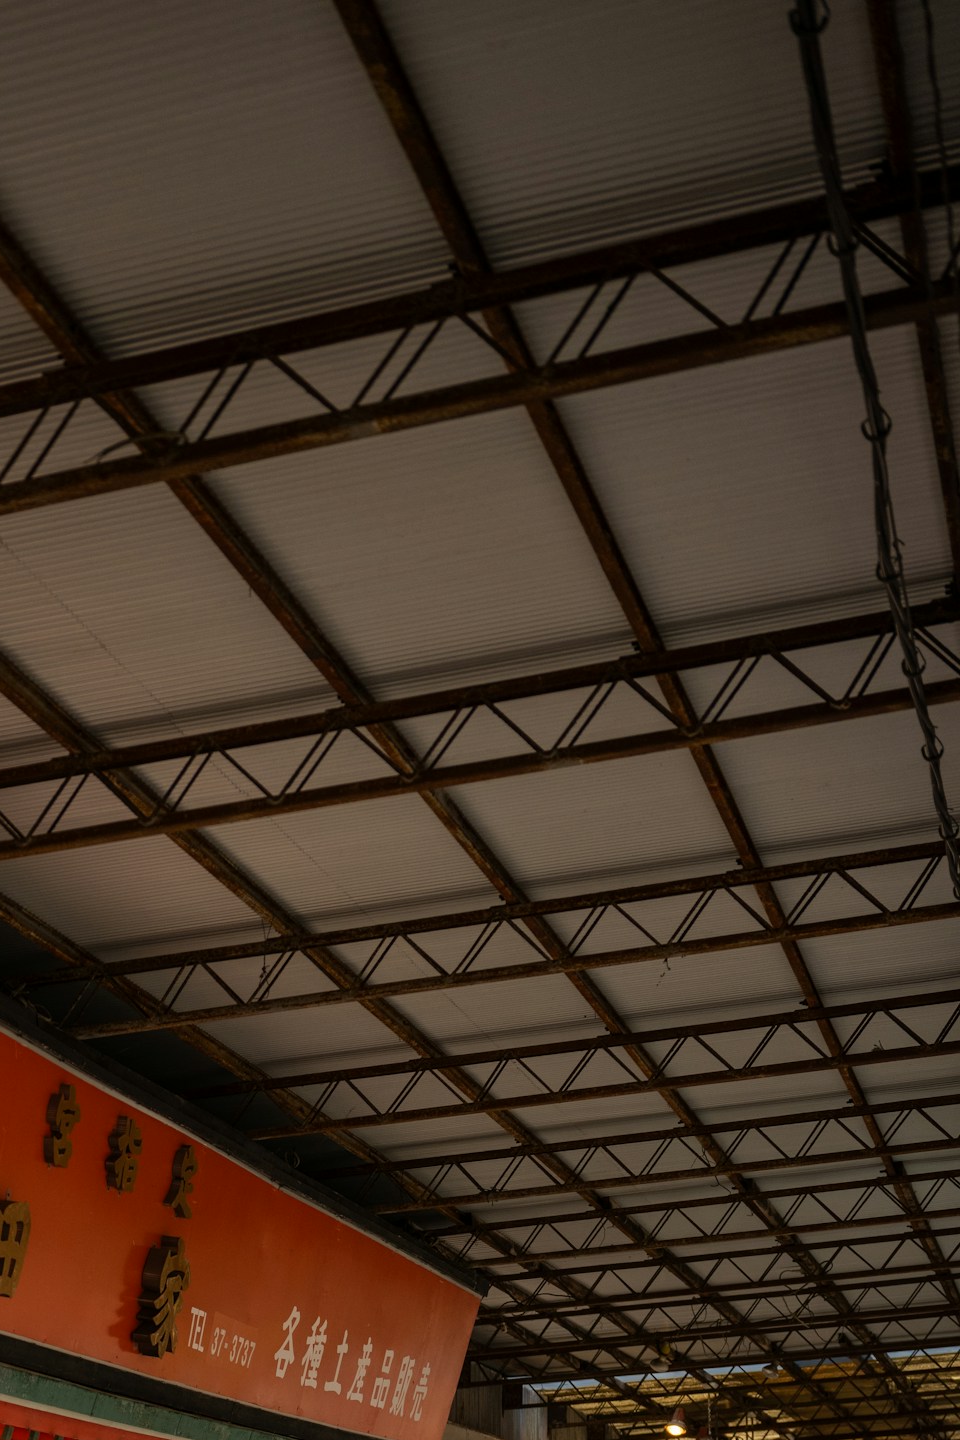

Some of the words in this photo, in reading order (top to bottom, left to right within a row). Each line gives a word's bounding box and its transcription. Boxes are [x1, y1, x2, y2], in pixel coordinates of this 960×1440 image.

[188, 1306, 208, 1352] TEL
[211, 1326, 256, 1369] 37-3737
[274, 1305, 432, 1422] 各種土産品販売
